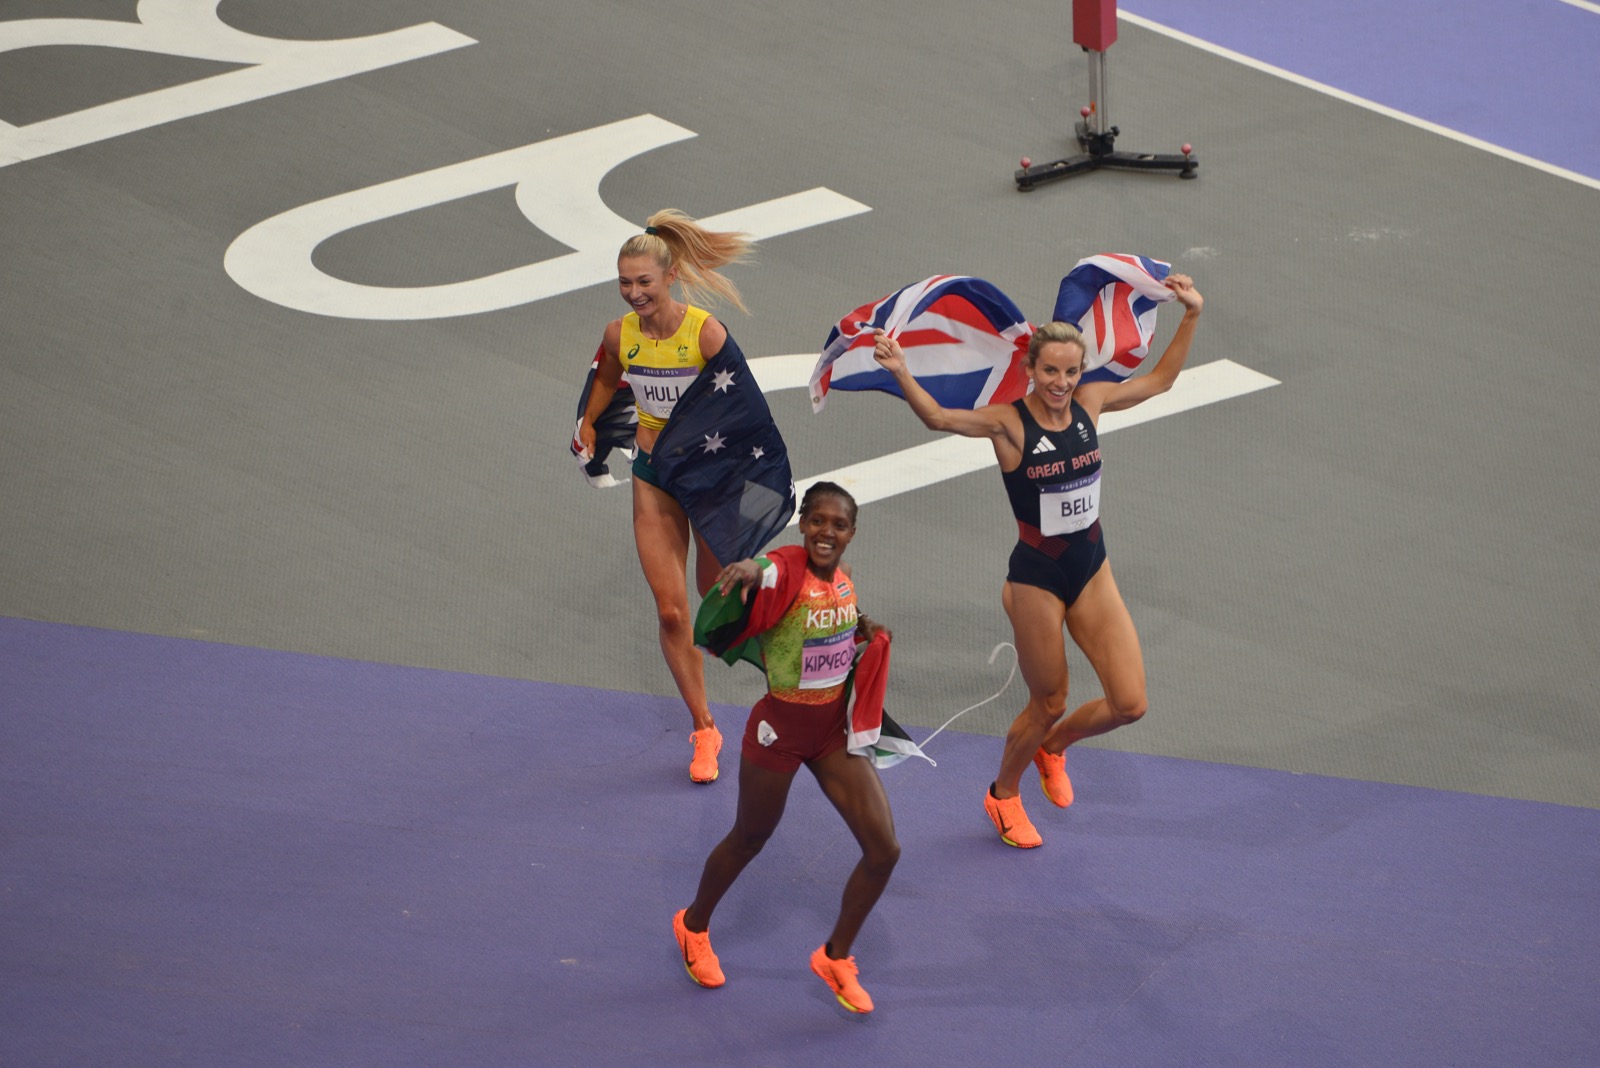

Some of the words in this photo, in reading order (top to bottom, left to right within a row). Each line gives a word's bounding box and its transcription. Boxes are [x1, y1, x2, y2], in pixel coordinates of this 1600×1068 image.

[1026, 460, 1066, 480] GREAT
[1060, 481, 1079, 491] PARIS
[1079, 477, 1094, 487] 2024
[1061, 494, 1094, 518] BELL
[806, 602, 858, 629] KENYA
[823, 635, 841, 644] PARIS
